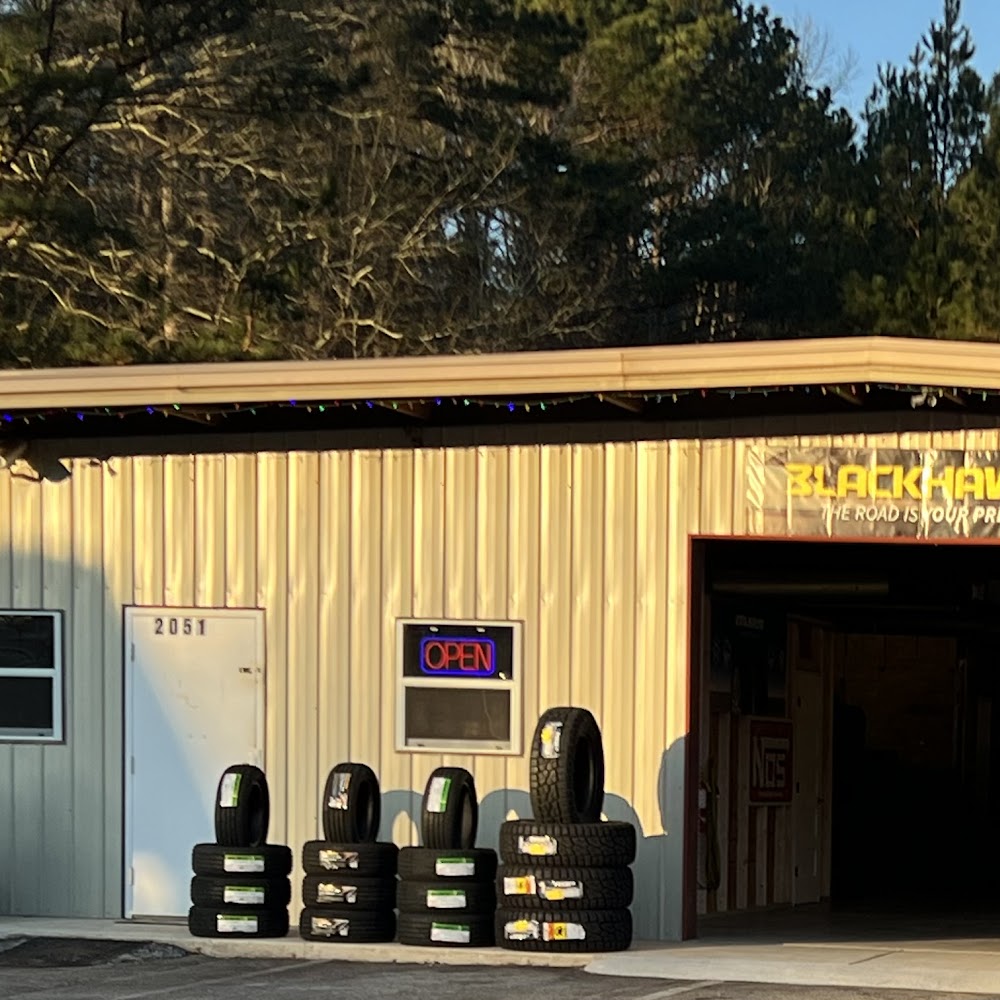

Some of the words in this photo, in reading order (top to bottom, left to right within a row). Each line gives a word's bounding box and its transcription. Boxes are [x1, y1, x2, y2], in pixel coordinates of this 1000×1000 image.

[821, 504, 850, 521] THE
[856, 505, 900, 523] ROAD
[903, 506, 920, 524] IS
[921, 506, 968, 525] YOUR
[155, 618, 205, 635] 2051
[425, 641, 492, 671] OPEN
